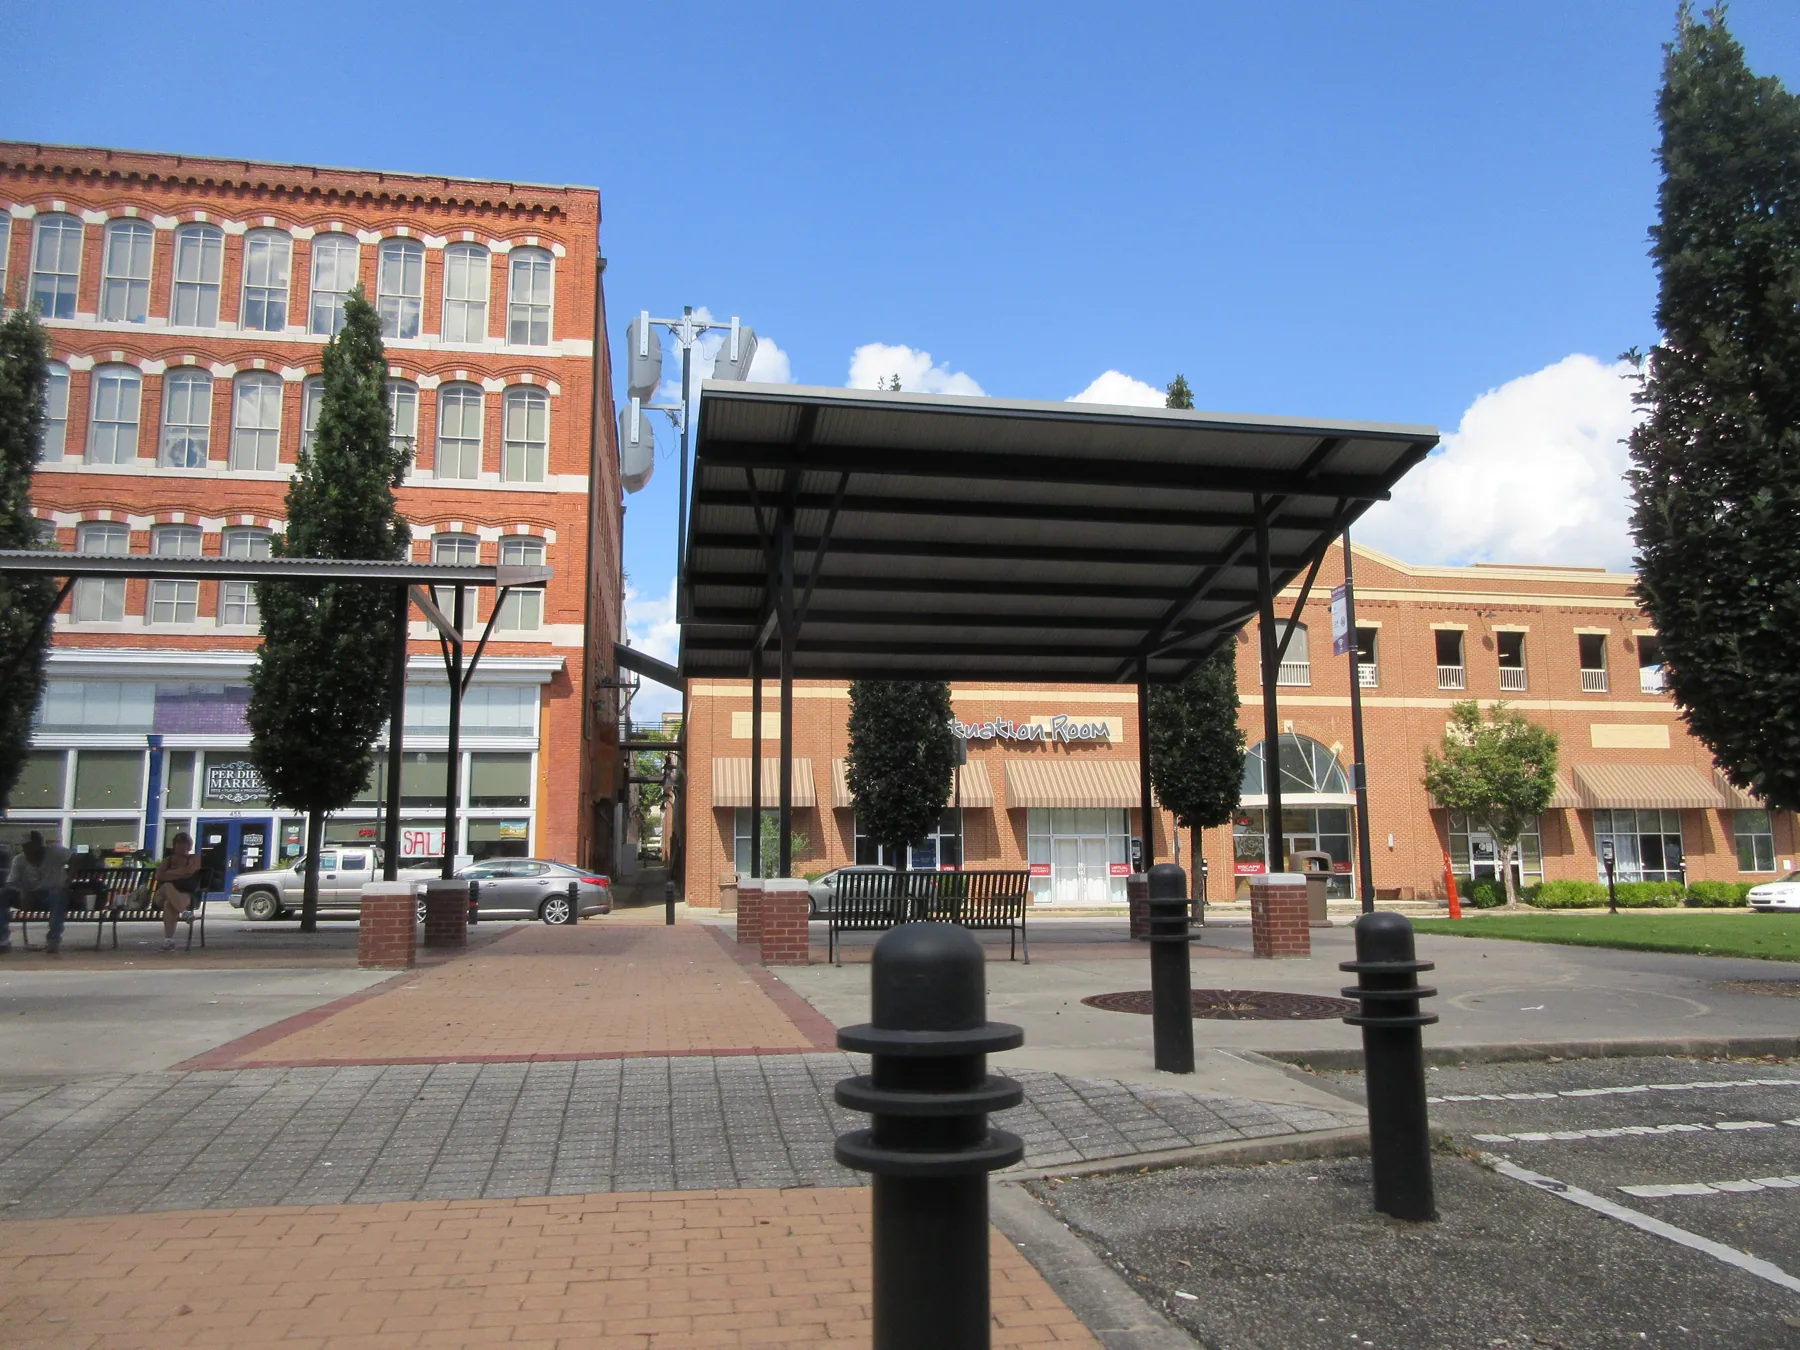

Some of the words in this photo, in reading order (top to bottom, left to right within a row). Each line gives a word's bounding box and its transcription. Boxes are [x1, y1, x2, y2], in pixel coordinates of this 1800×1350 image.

[947, 714, 1046, 740] tuation
[211, 770, 234, 779] PER
[237, 770, 262, 779] DIE
[210, 779, 265, 788] MARKE
